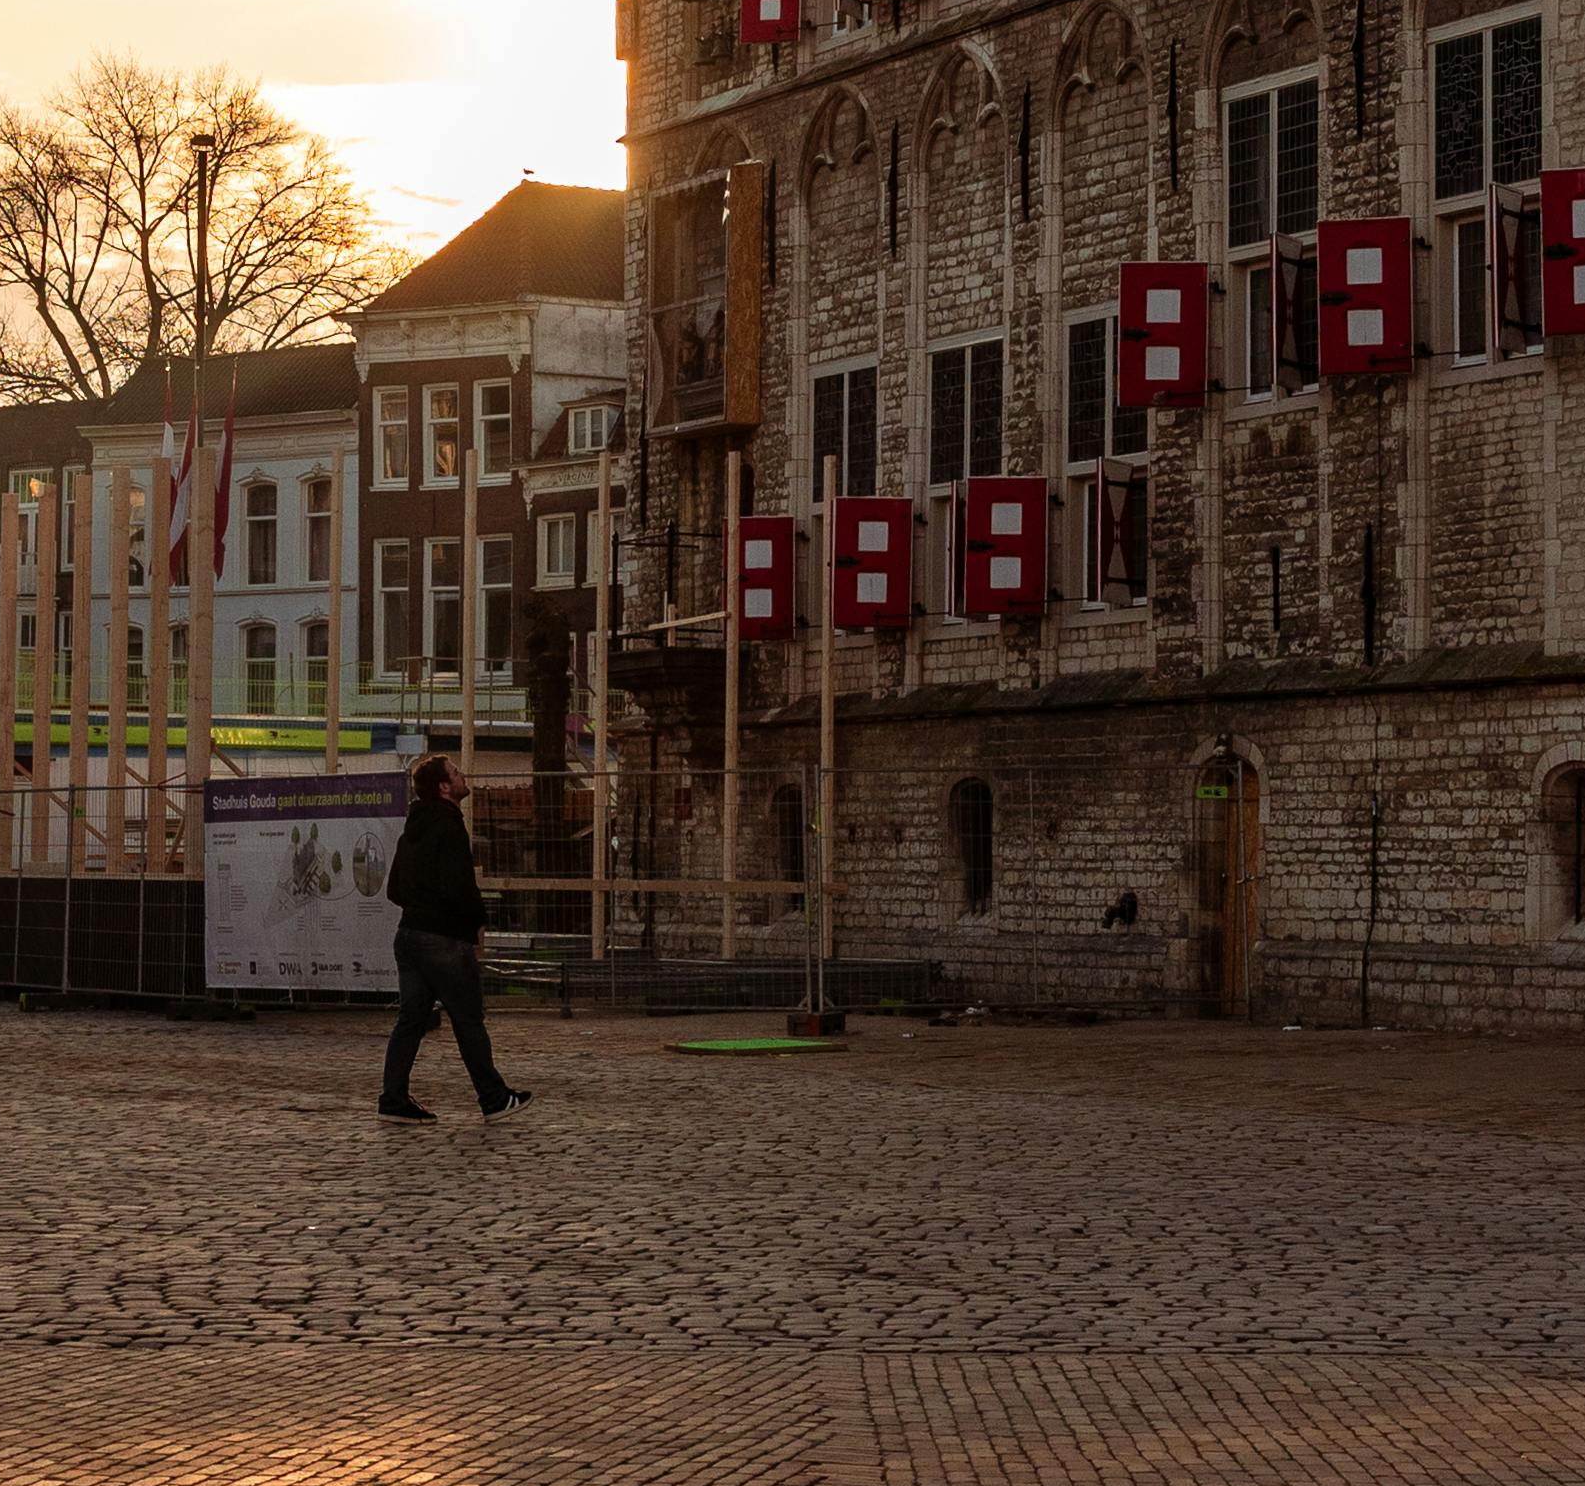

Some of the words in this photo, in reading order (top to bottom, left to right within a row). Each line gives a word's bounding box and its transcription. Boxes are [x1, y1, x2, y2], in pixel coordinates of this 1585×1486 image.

[212, 795, 248, 810] Stadhuis
[249, 793, 276, 808] Gouda
[277, 794, 296, 811] gaat
[298, 792, 341, 807] duurzaam
[342, 790, 353, 805] de
[383, 789, 392, 804] in
